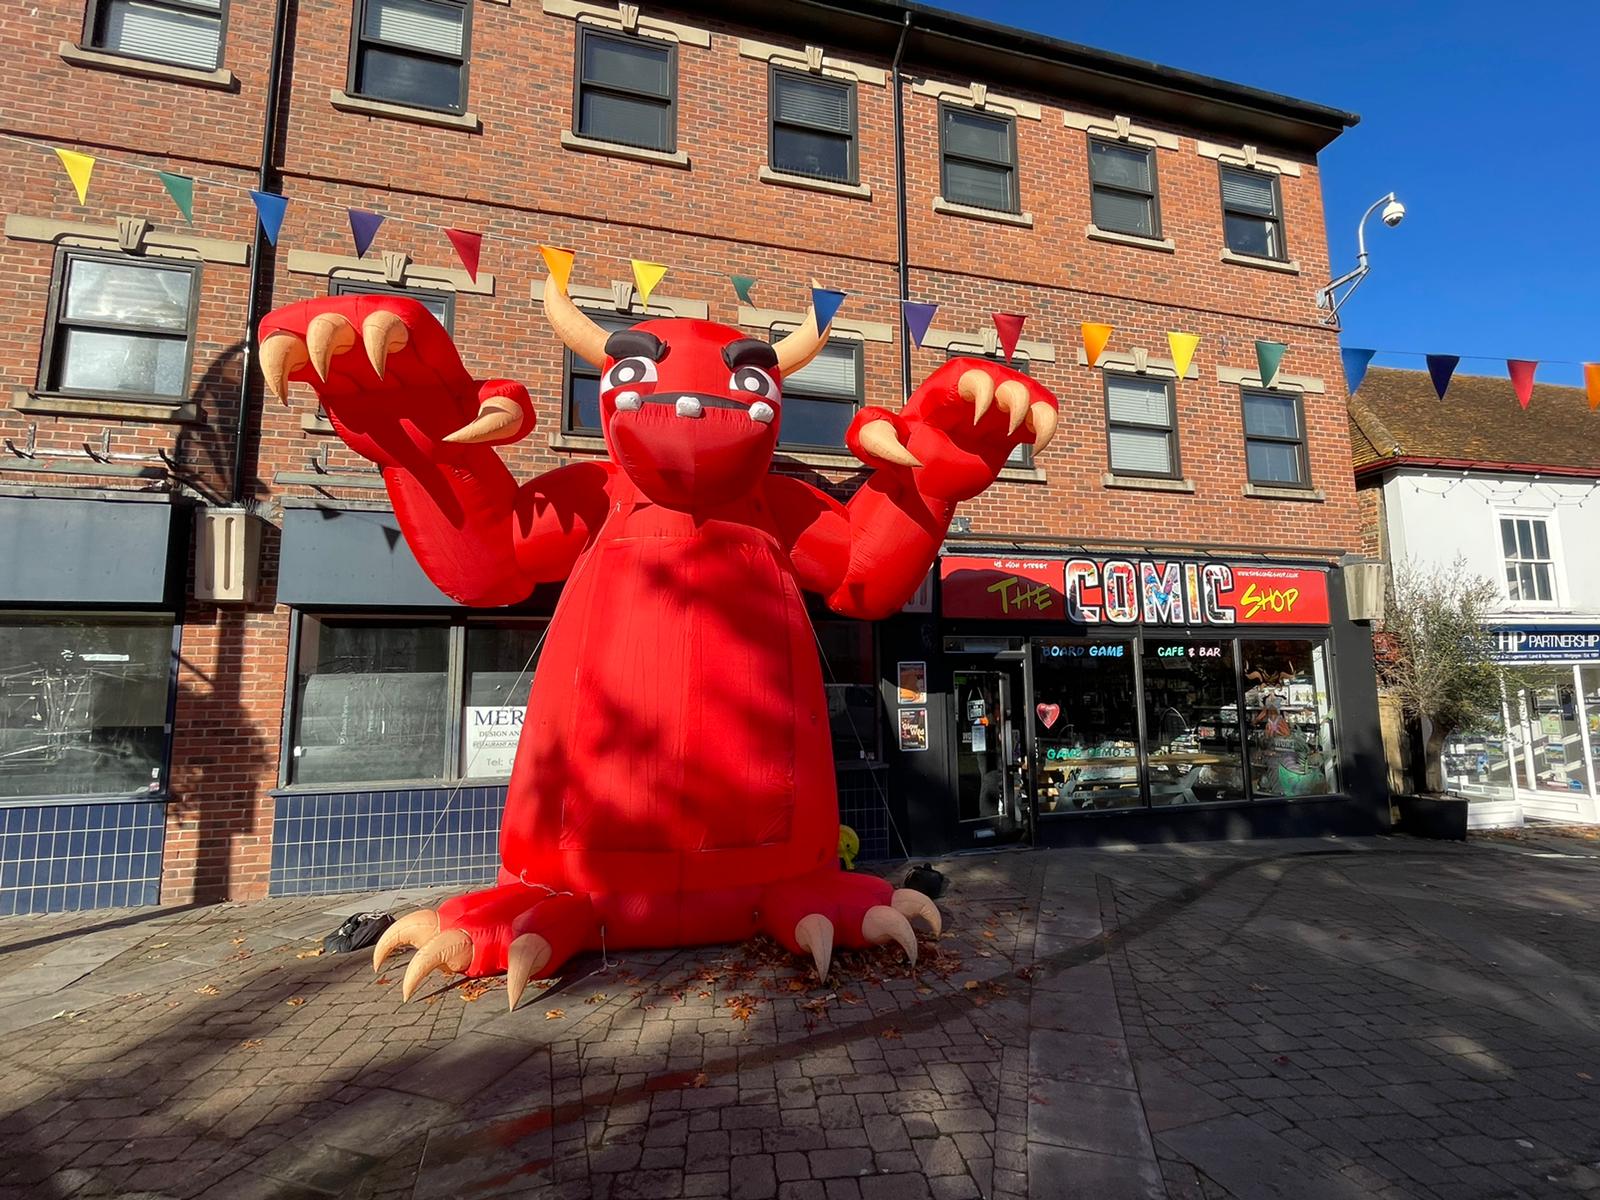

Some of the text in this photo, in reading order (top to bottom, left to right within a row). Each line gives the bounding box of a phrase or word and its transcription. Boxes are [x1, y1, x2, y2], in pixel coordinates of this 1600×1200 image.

[986, 559, 1300, 624] THE COMIC SHOP
[1498, 630, 1527, 652] HP
[1528, 634, 1600, 648] PARTNERSHIP
[1042, 646, 1085, 657] BOARD
[1088, 645, 1124, 657] GAME
[1157, 646, 1185, 658] CAFE
[1199, 646, 1221, 658] BAR
[479, 730, 507, 738] DESIGN
[486, 758, 504, 767] Tel:
